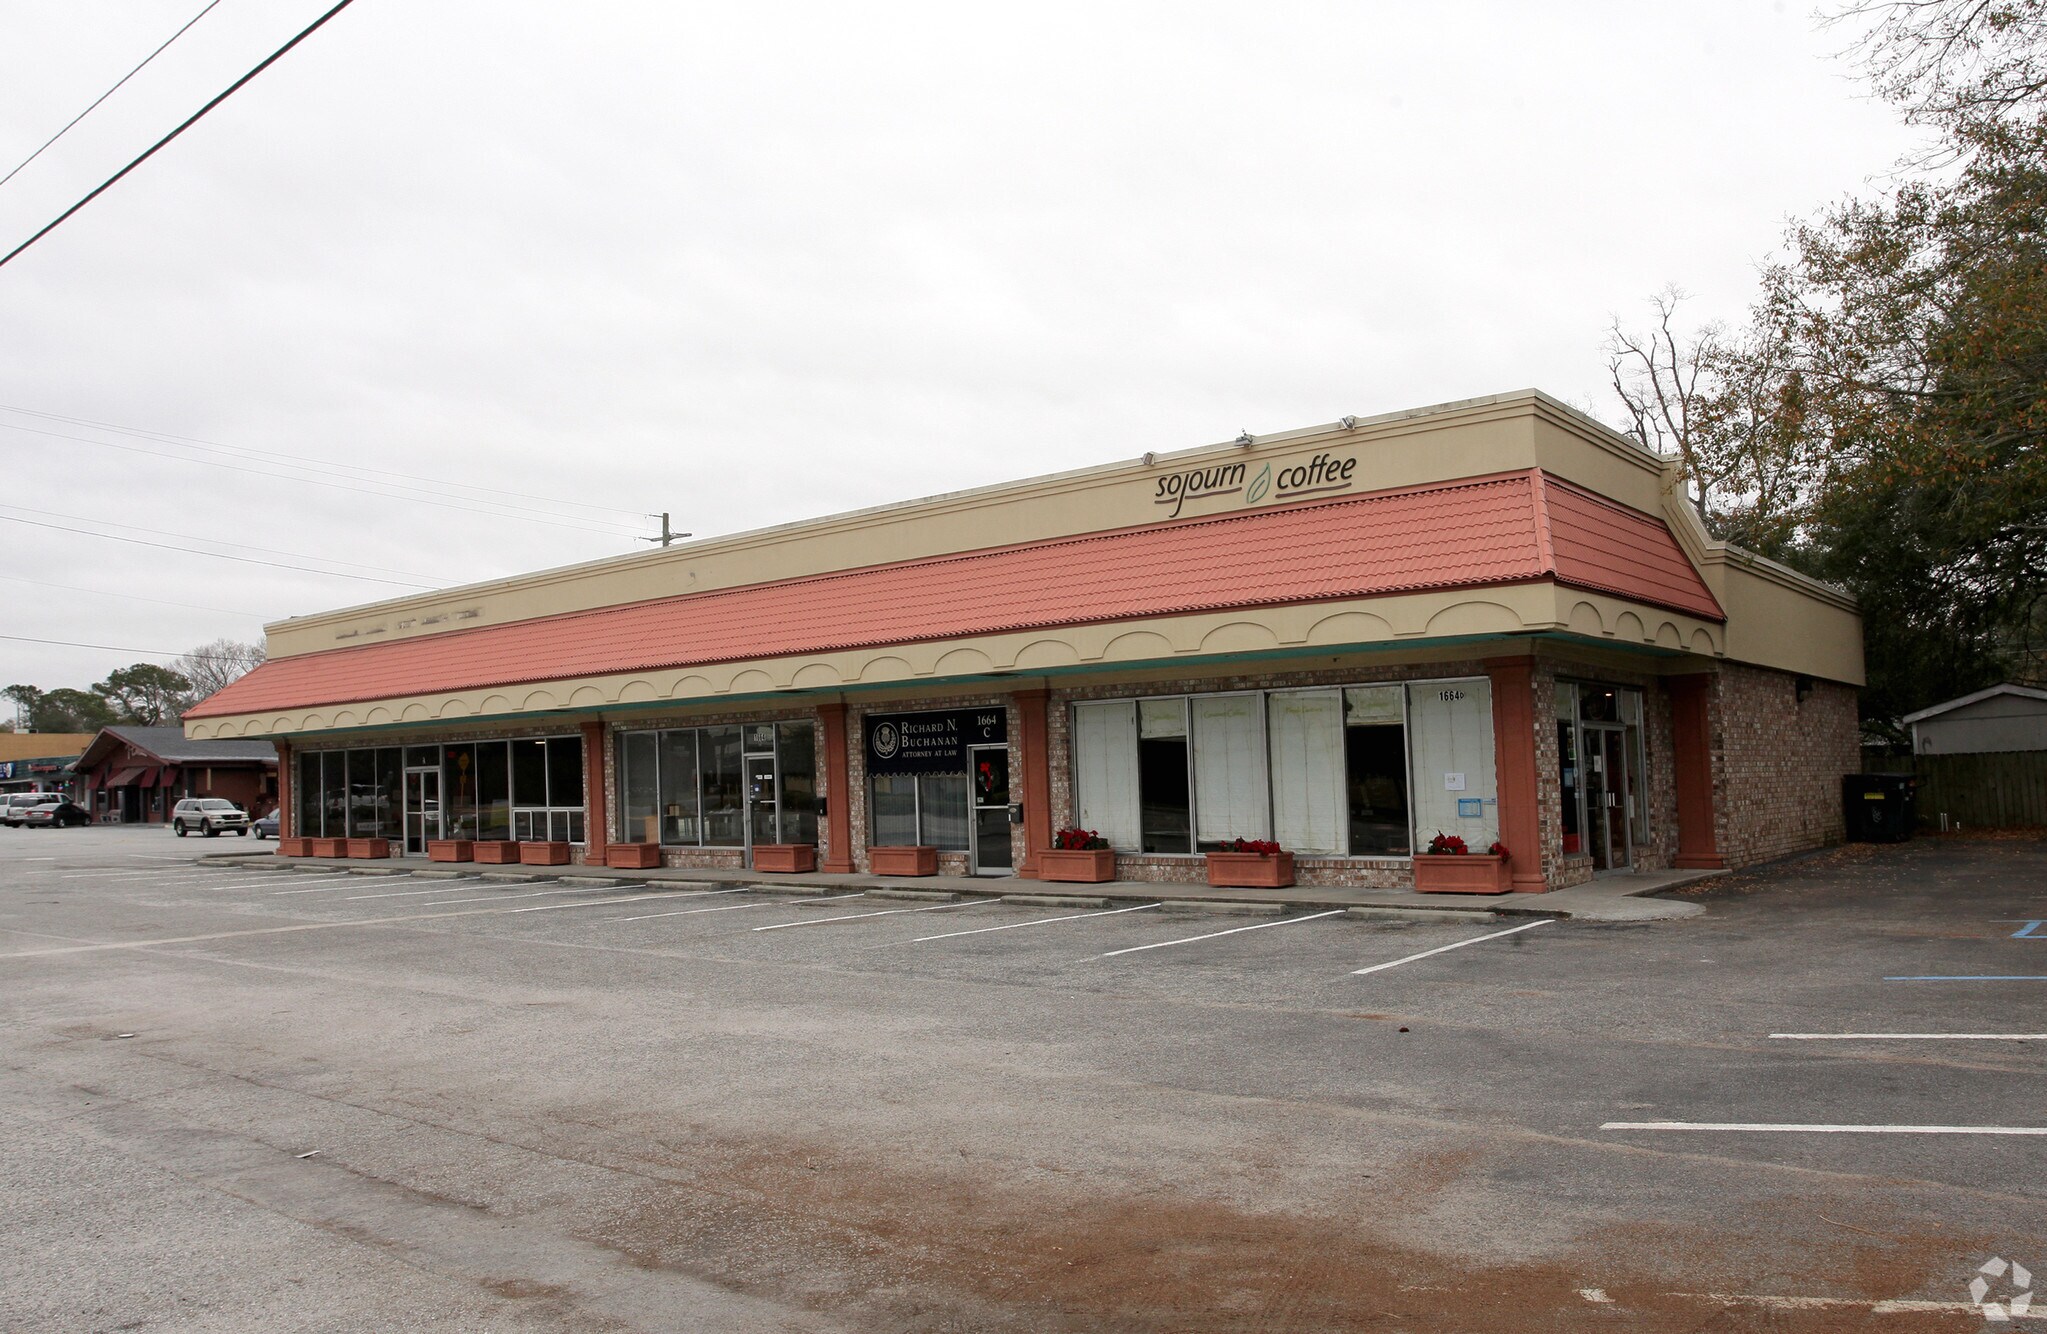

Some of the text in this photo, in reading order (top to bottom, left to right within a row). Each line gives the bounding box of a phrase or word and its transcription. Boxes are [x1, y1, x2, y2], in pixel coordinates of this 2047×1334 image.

[1155, 453, 1357, 518] sojourn coffee
[901, 718, 958, 734] RICHARD N.
[977, 714, 997, 726] 1664
[983, 726, 991, 738] C
[901, 735, 958, 748] BUCHANAN
